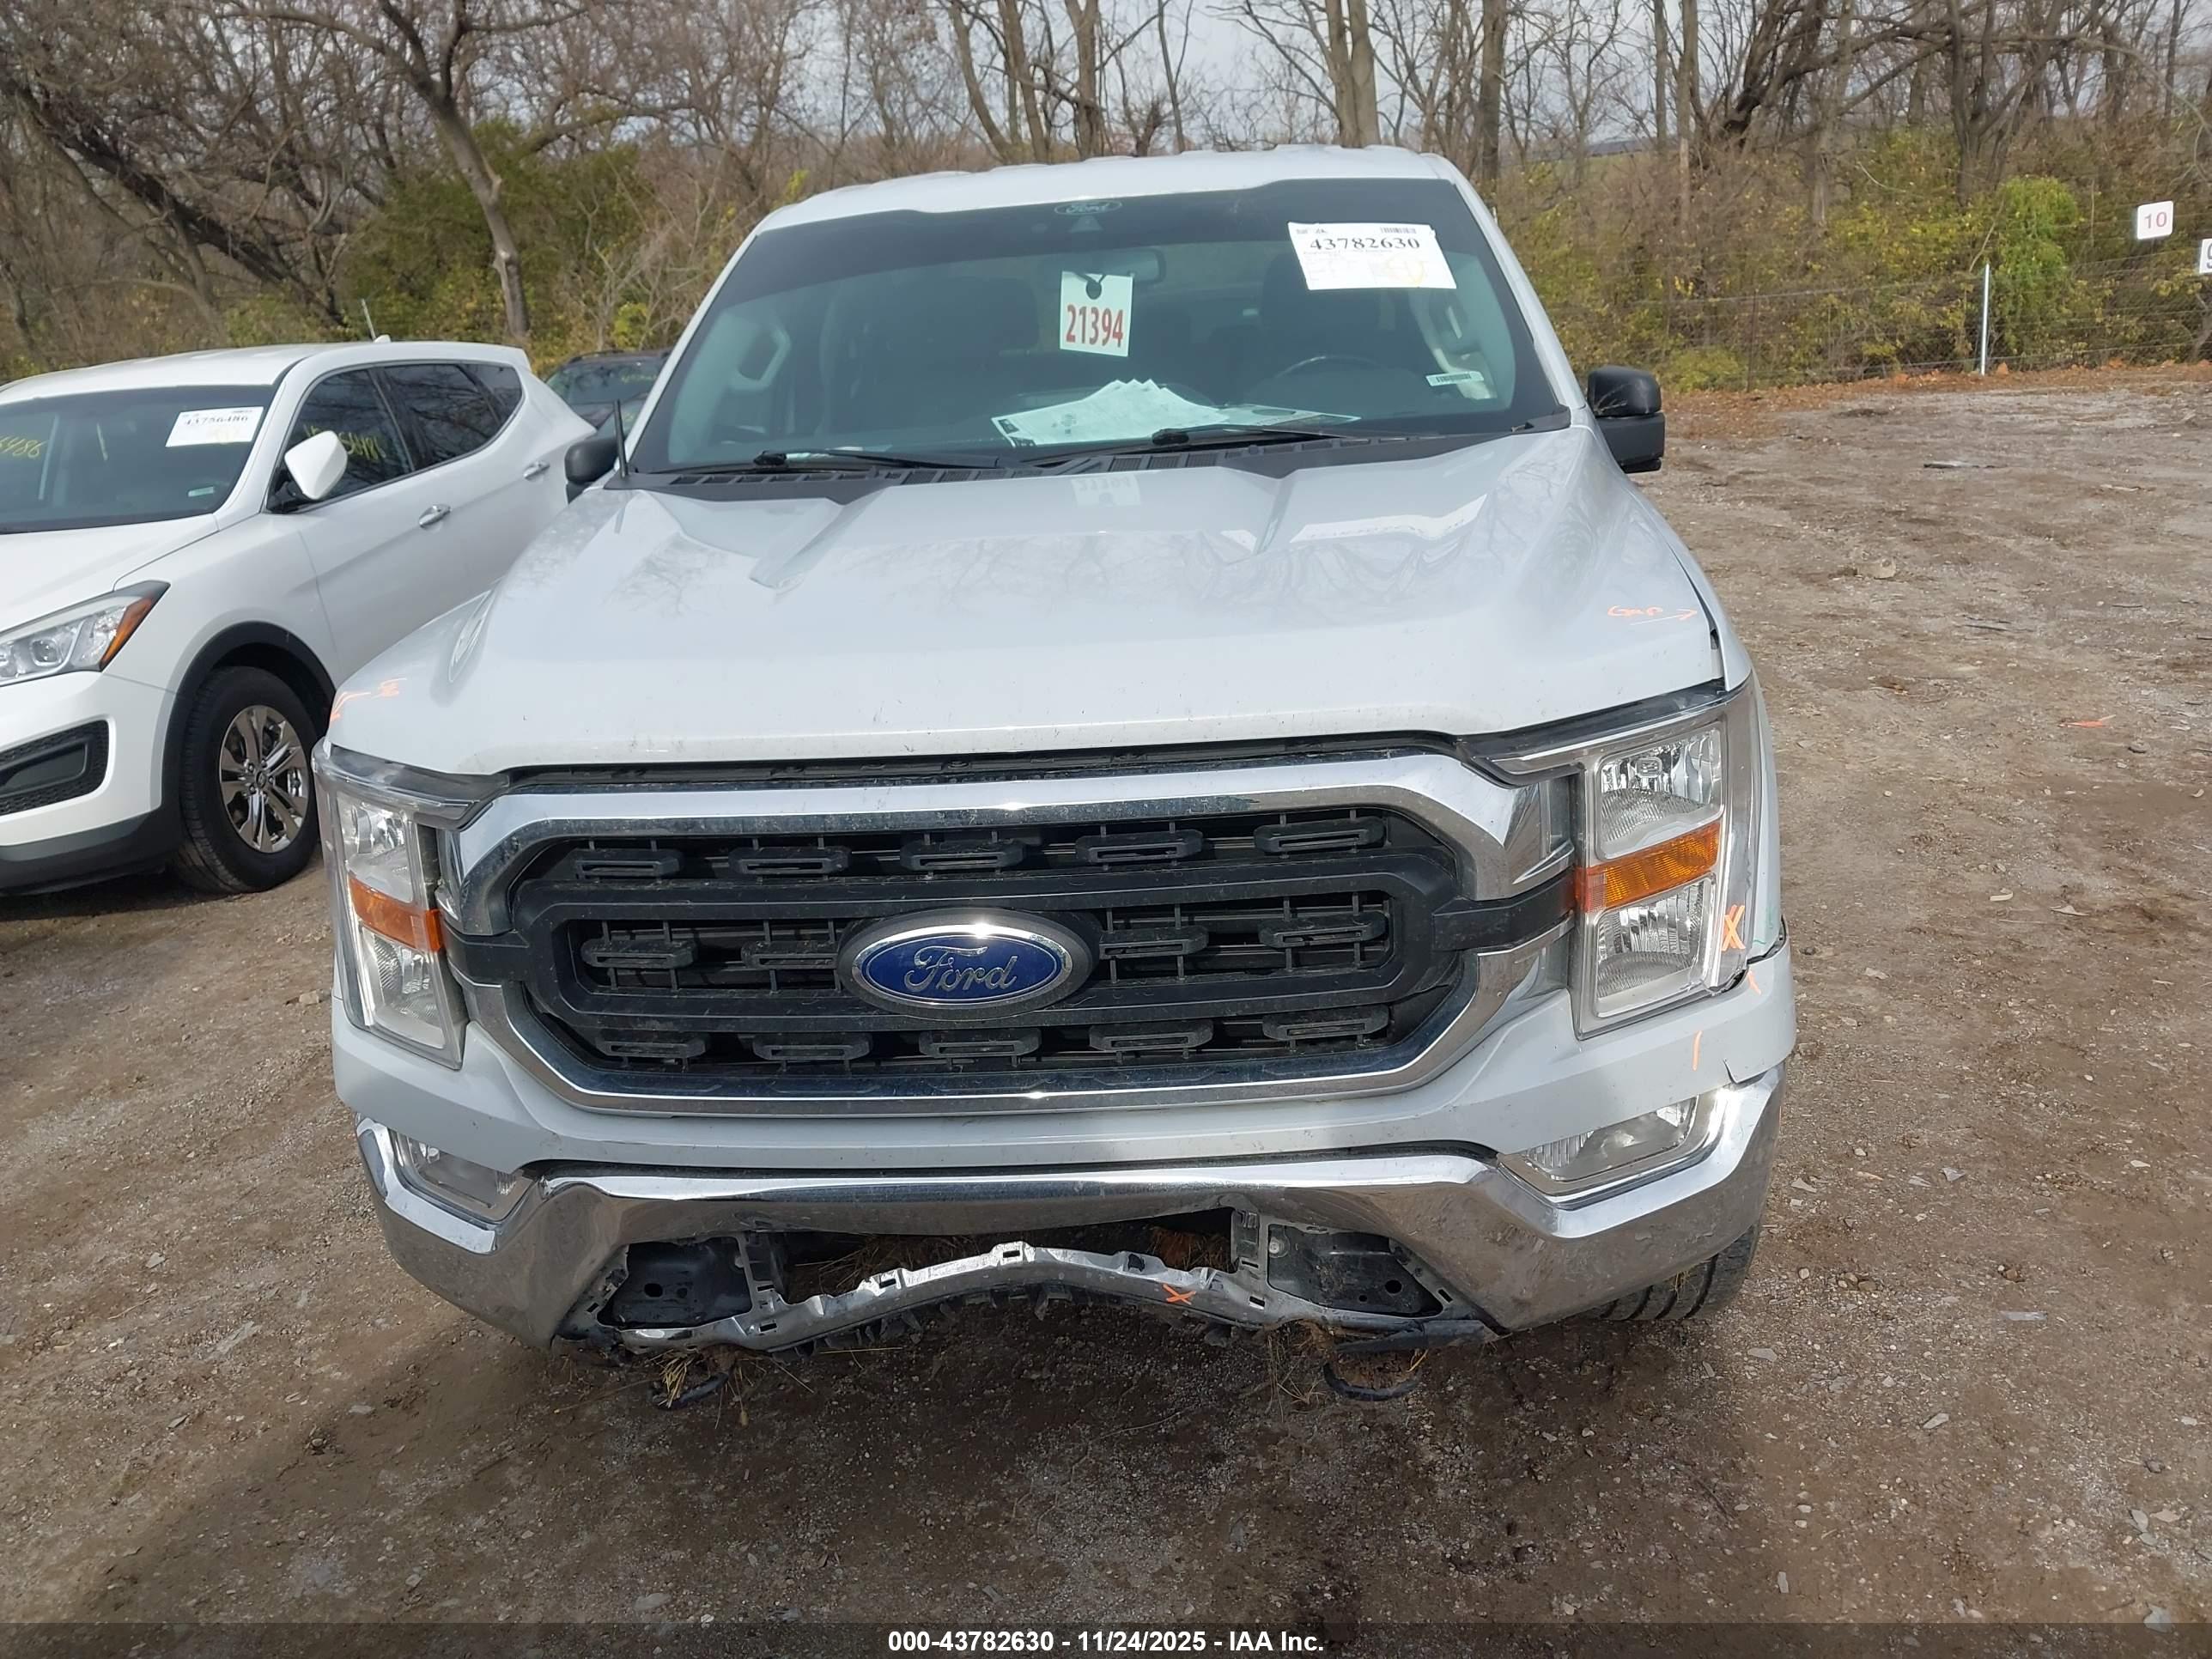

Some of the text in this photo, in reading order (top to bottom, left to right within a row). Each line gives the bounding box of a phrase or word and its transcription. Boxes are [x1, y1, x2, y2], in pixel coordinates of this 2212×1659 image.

[2144, 211, 2167, 229] 10
[1310, 238, 1420, 251] 43782630
[1066, 304, 1123, 348] 21394
[904, 945, 1018, 992] Ford
